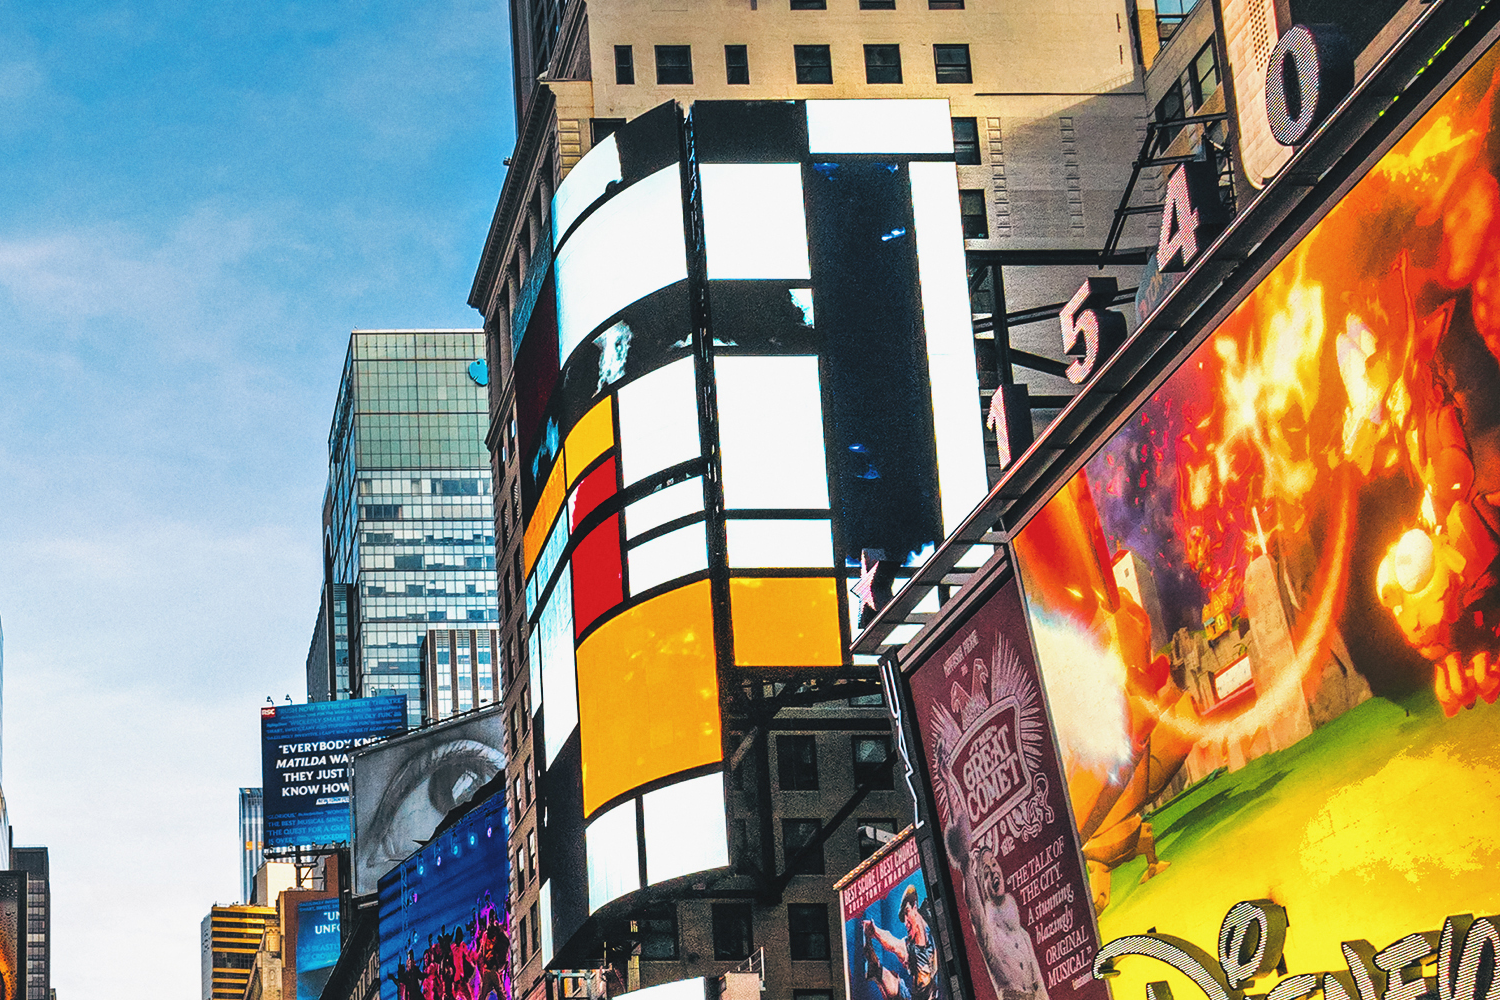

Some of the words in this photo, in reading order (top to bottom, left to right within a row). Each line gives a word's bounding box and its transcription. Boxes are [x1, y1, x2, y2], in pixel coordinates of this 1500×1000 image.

[276, 755, 327, 769] MATILDA
[283, 771, 314, 782] THEY
[316, 768, 344, 780] JUST
[963, 723, 1010, 791] GREAT
[282, 785, 320, 797] KNOW
[966, 753, 1019, 822] COMET
[1029, 844, 1053, 880] TALK
[1053, 835, 1065, 858] OF
[844, 882, 858, 906] BEST
[858, 869, 876, 895] SCORE
[880, 855, 893, 880] BEST
[865, 882, 881, 901] TONY
[884, 864, 906, 888] AWARD
[1020, 885, 1040, 906] THE
[1028, 907, 1034, 926] A
[1034, 883, 1074, 919] stunning
[1035, 904, 1074, 945] blazingly
[1046, 925, 1089, 966] ORIGINAL
